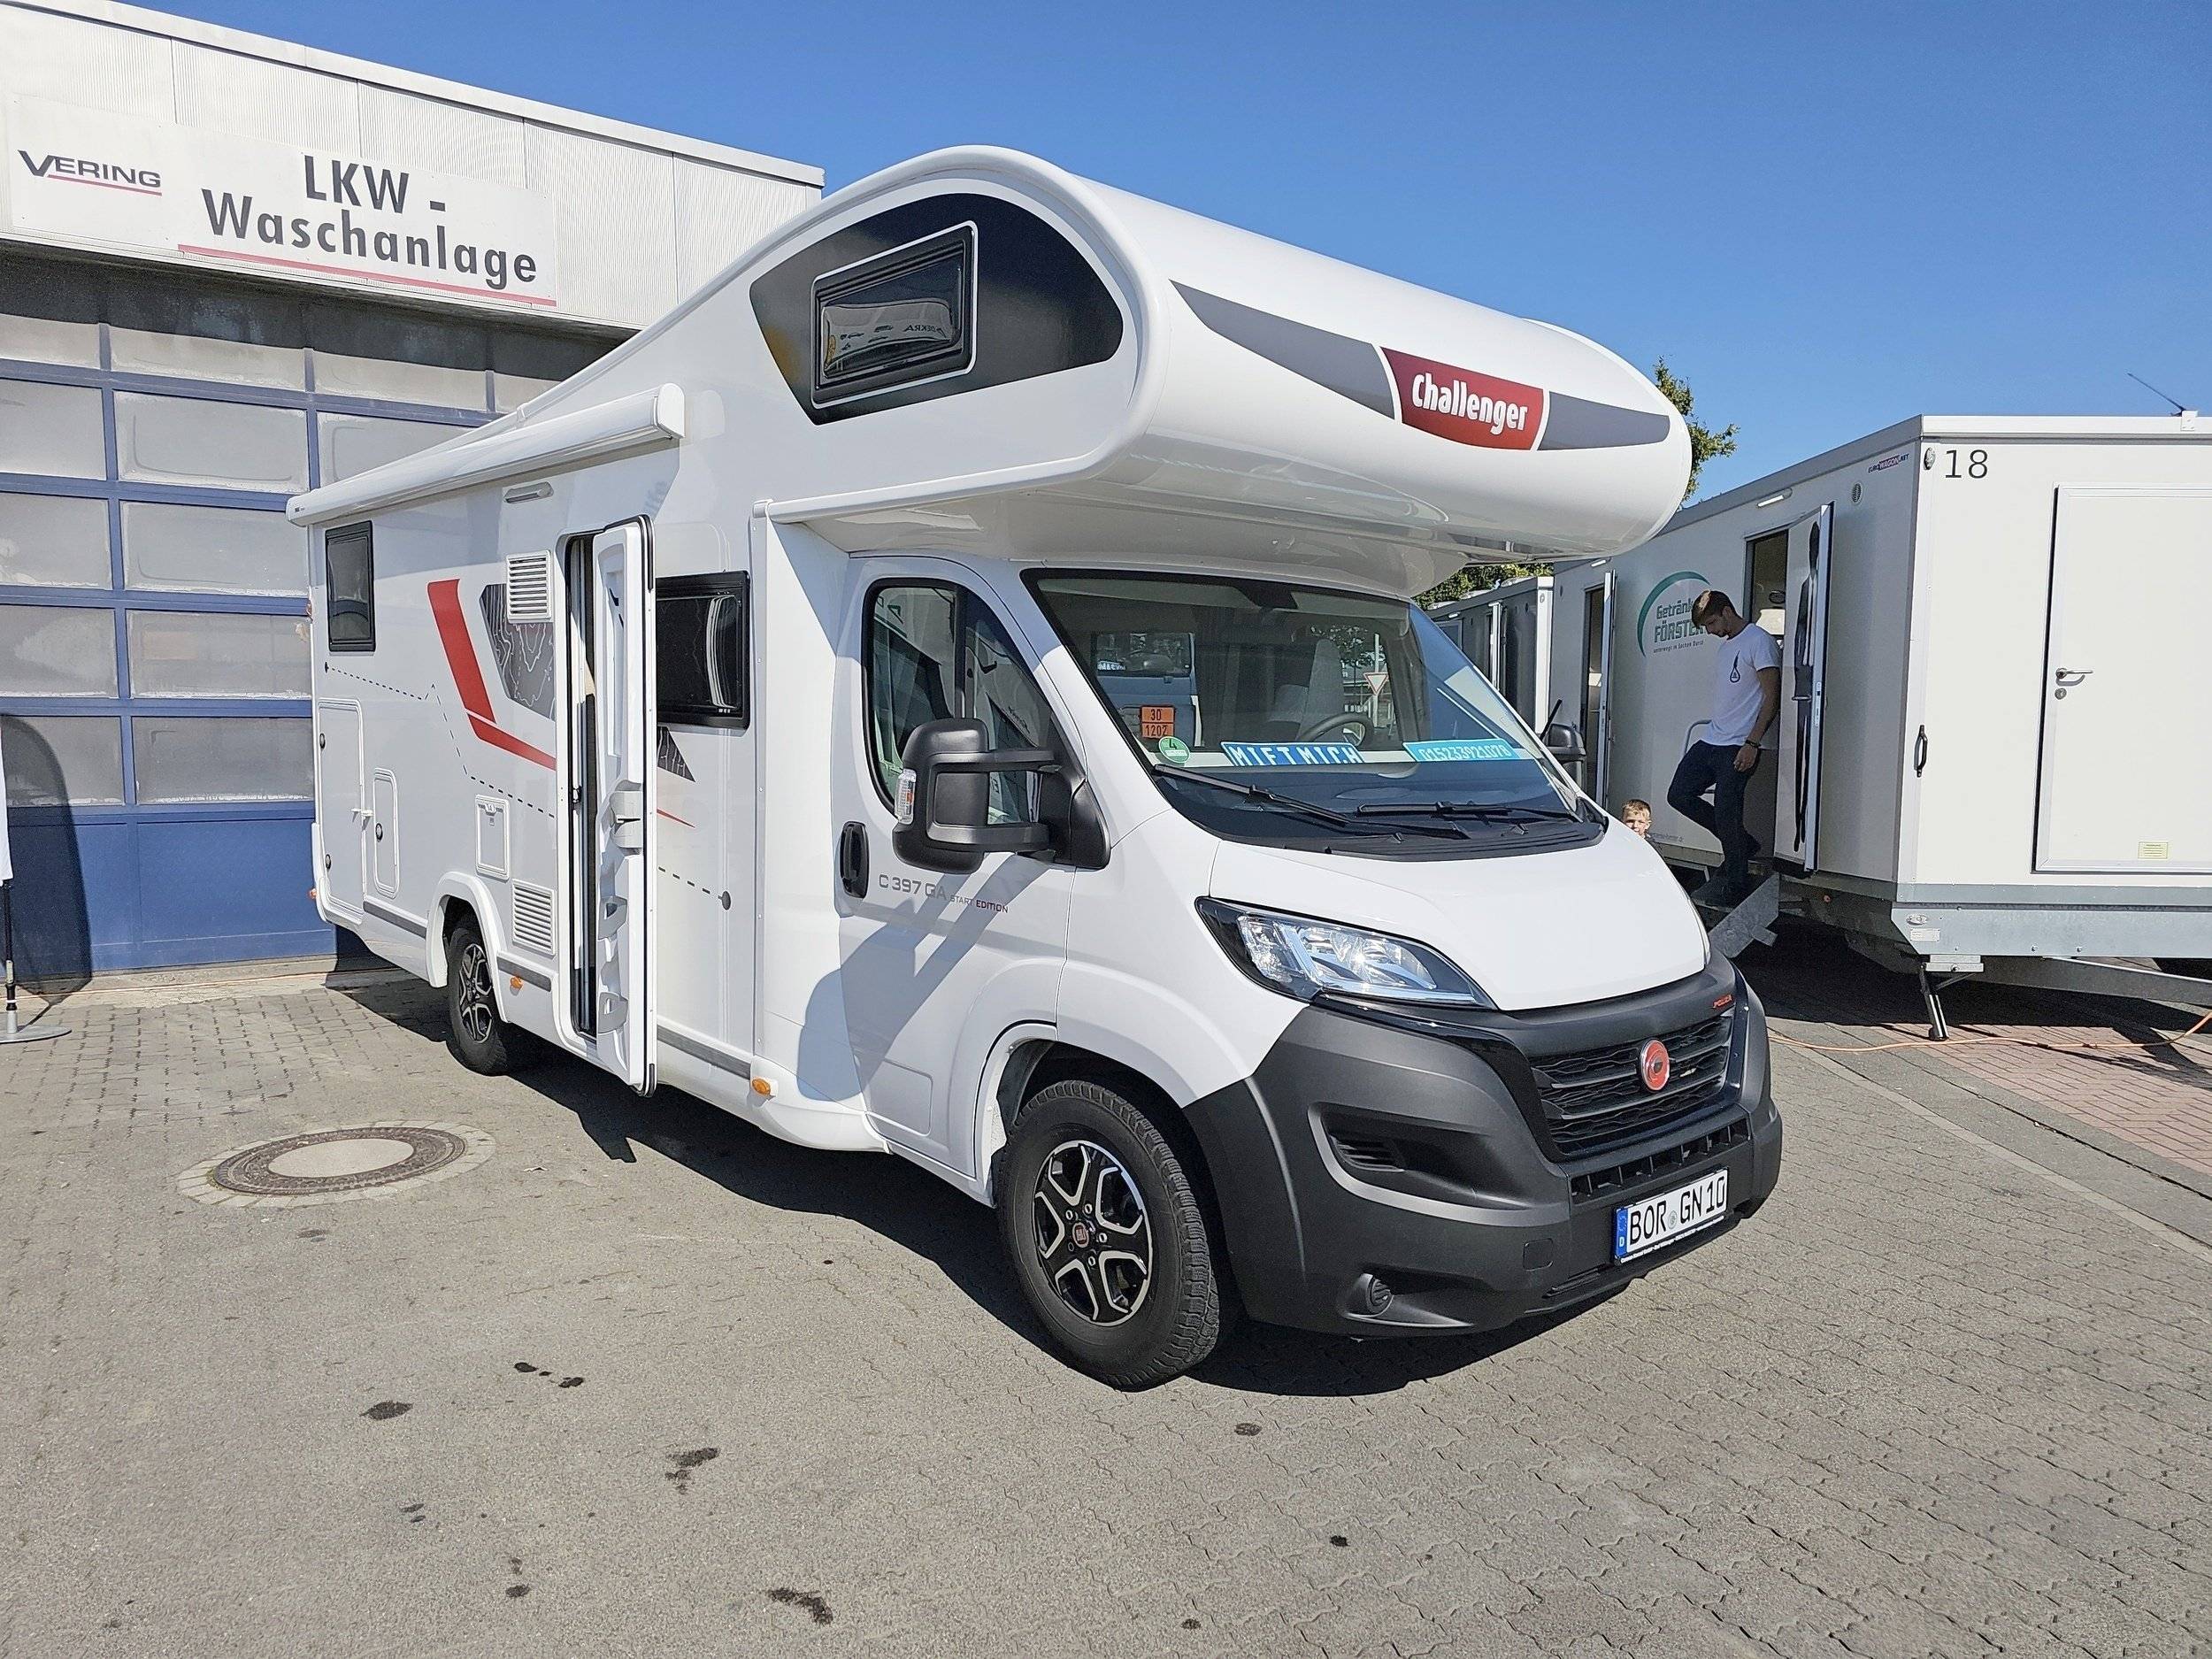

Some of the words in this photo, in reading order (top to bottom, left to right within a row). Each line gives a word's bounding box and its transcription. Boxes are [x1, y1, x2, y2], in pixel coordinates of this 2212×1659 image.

[18, 150, 161, 188] VERING
[304, 155, 409, 214] LKW
[202, 188, 537, 290] Waschanlage
[1411, 373, 1528, 435] Challenger
[1945, 449, 1988, 479] 18
[1150, 709, 1162, 721] 30
[1146, 725, 1167, 737] 1202
[1169, 738, 1178, 749] 4
[879, 874, 888, 888] C
[892, 877, 922, 895] 397
[925, 883, 947, 901] GA
[950, 895, 973, 906] START
[976, 899, 1009, 913] EDITION
[1630, 1200, 1666, 1245] BOR
[1680, 1186, 1702, 1224] GN
[1706, 1176, 1725, 1213] 10
